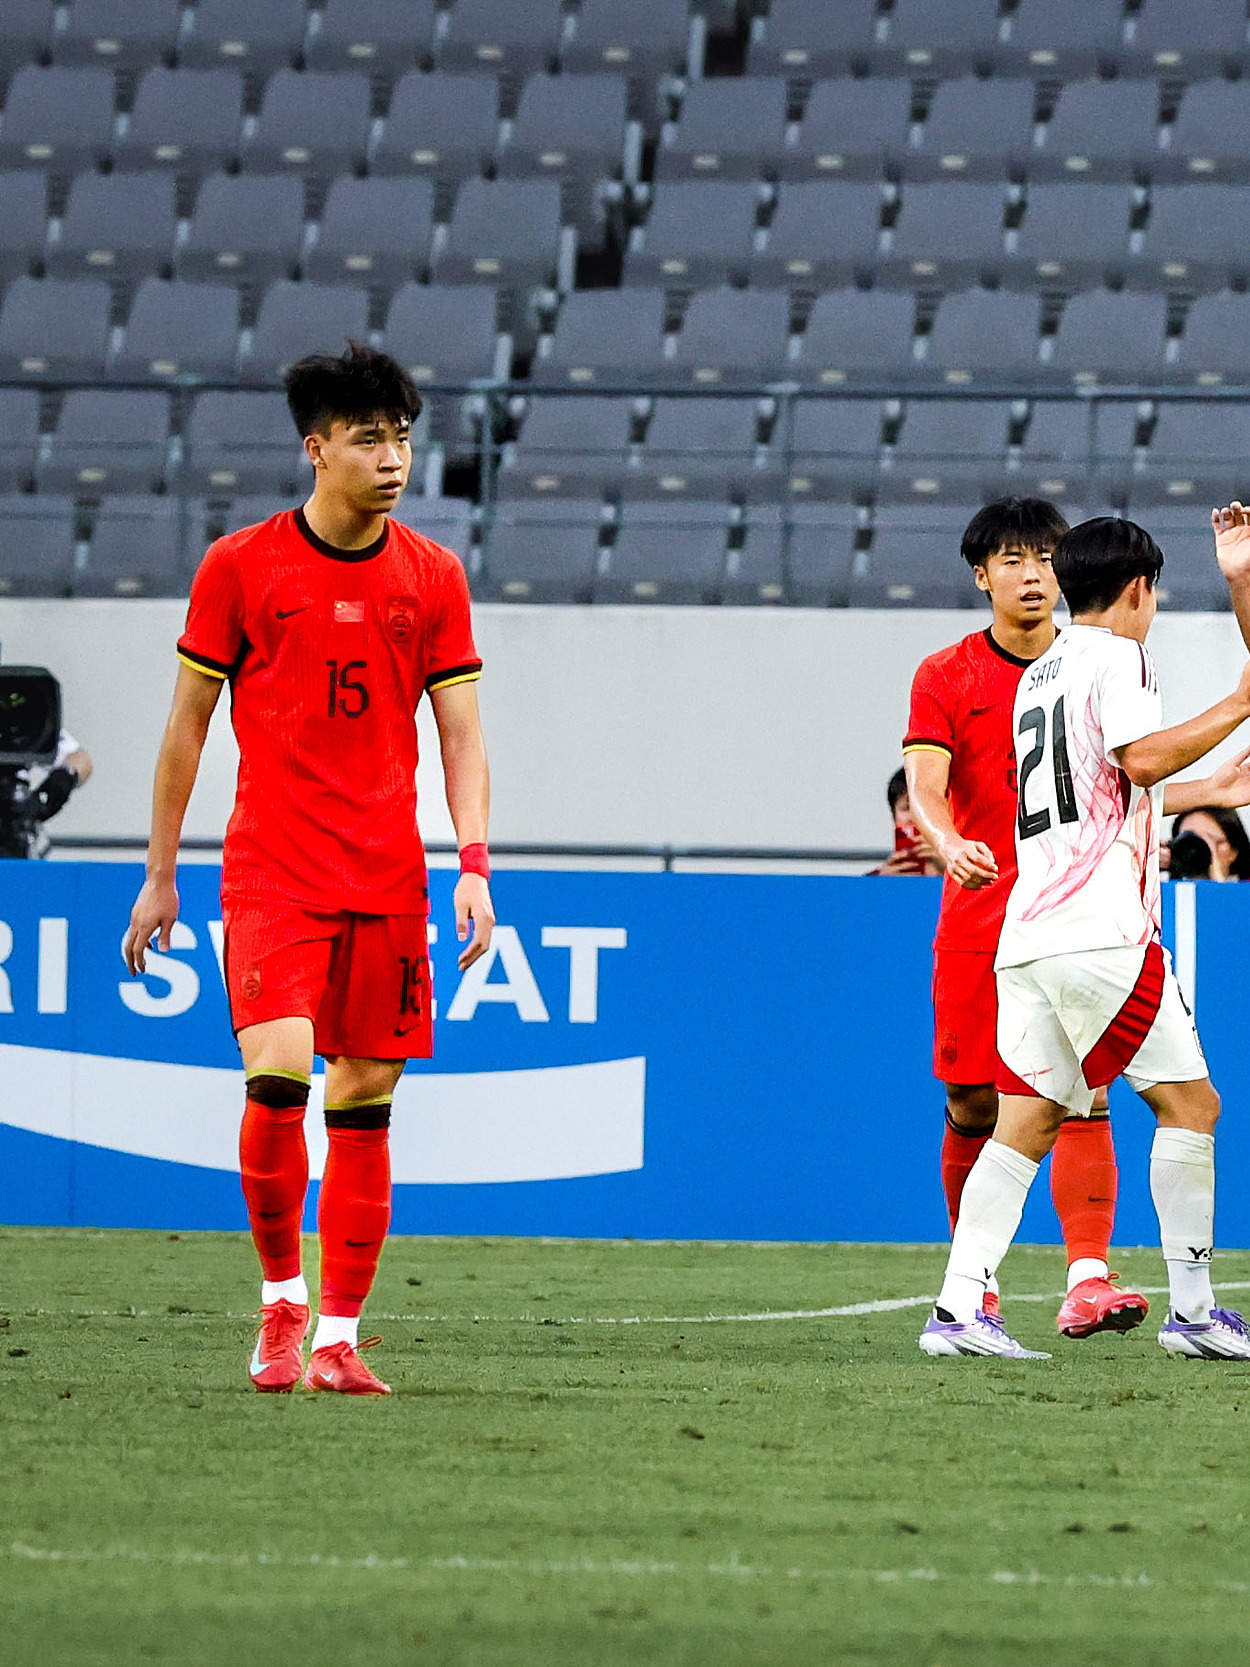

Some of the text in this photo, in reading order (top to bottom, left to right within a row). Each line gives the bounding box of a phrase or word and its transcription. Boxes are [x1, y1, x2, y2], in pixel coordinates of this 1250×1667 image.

[326, 660, 370, 719] 15
[1028, 656, 1063, 691] SATO
[1018, 694, 1079, 841] 21
